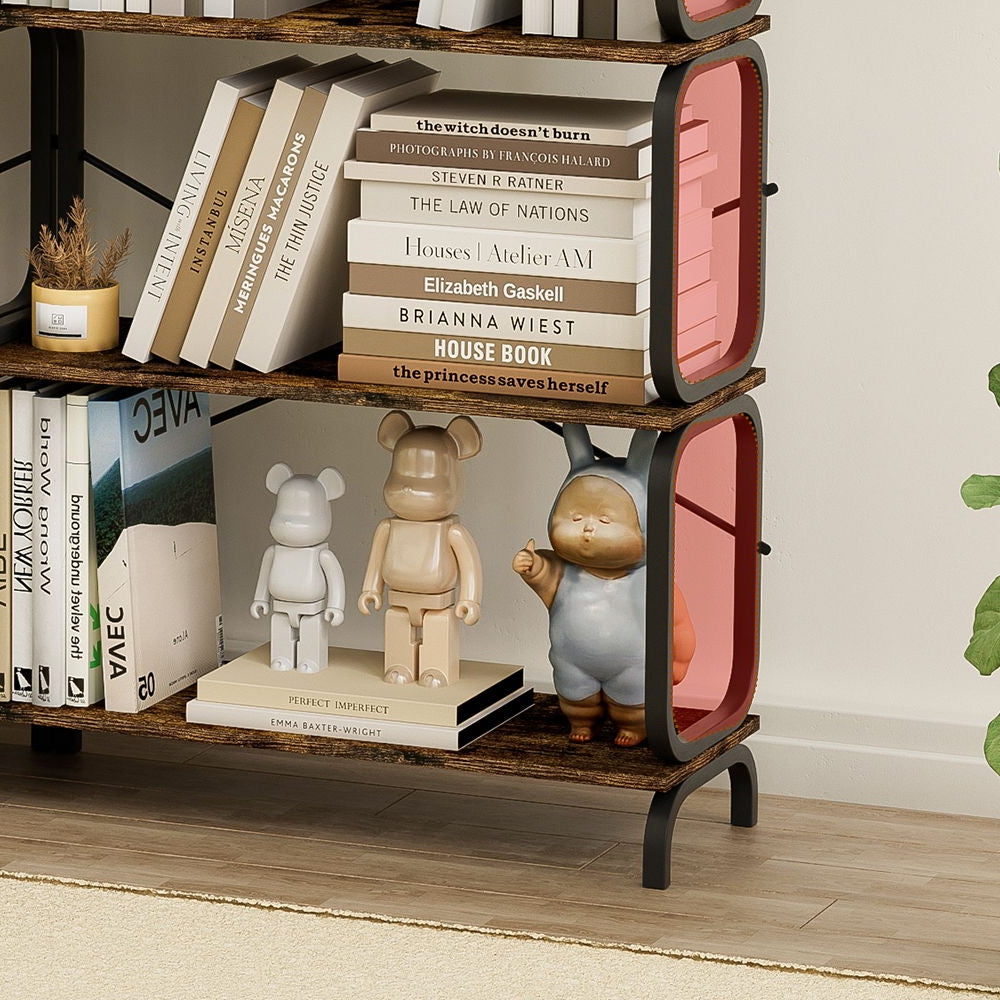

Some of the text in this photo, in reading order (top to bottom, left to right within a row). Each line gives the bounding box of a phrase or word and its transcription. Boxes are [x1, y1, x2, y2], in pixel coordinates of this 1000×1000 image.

[416, 120, 442, 133] the
[443, 122, 488, 137] witch
[552, 127, 591, 141] burn
[390, 143, 610, 167] PHOTOGRAPHS BY FRANÇOIS HALARD
[431, 170, 563, 191] STEVEN R RATNER
[233, 132, 306, 314] MERINGUES MACARONS
[274, 160, 329, 282] THE THIN JUSTICE
[409, 196, 589, 223] THE LAW OF NATIONS
[147, 149, 211, 301] LIVING INTENT
[190, 190, 228, 274] INSTANBUL
[406, 236, 592, 269] Houses Atelier AM
[424, 276, 563, 302] Elizabeth Gaskell
[434, 338, 552, 366] HOUSE BOOK
[288, 695, 389, 714] PERFECT IMPERFECT
[270, 718, 381, 737] EMMA BAXTER-WRIGHT
